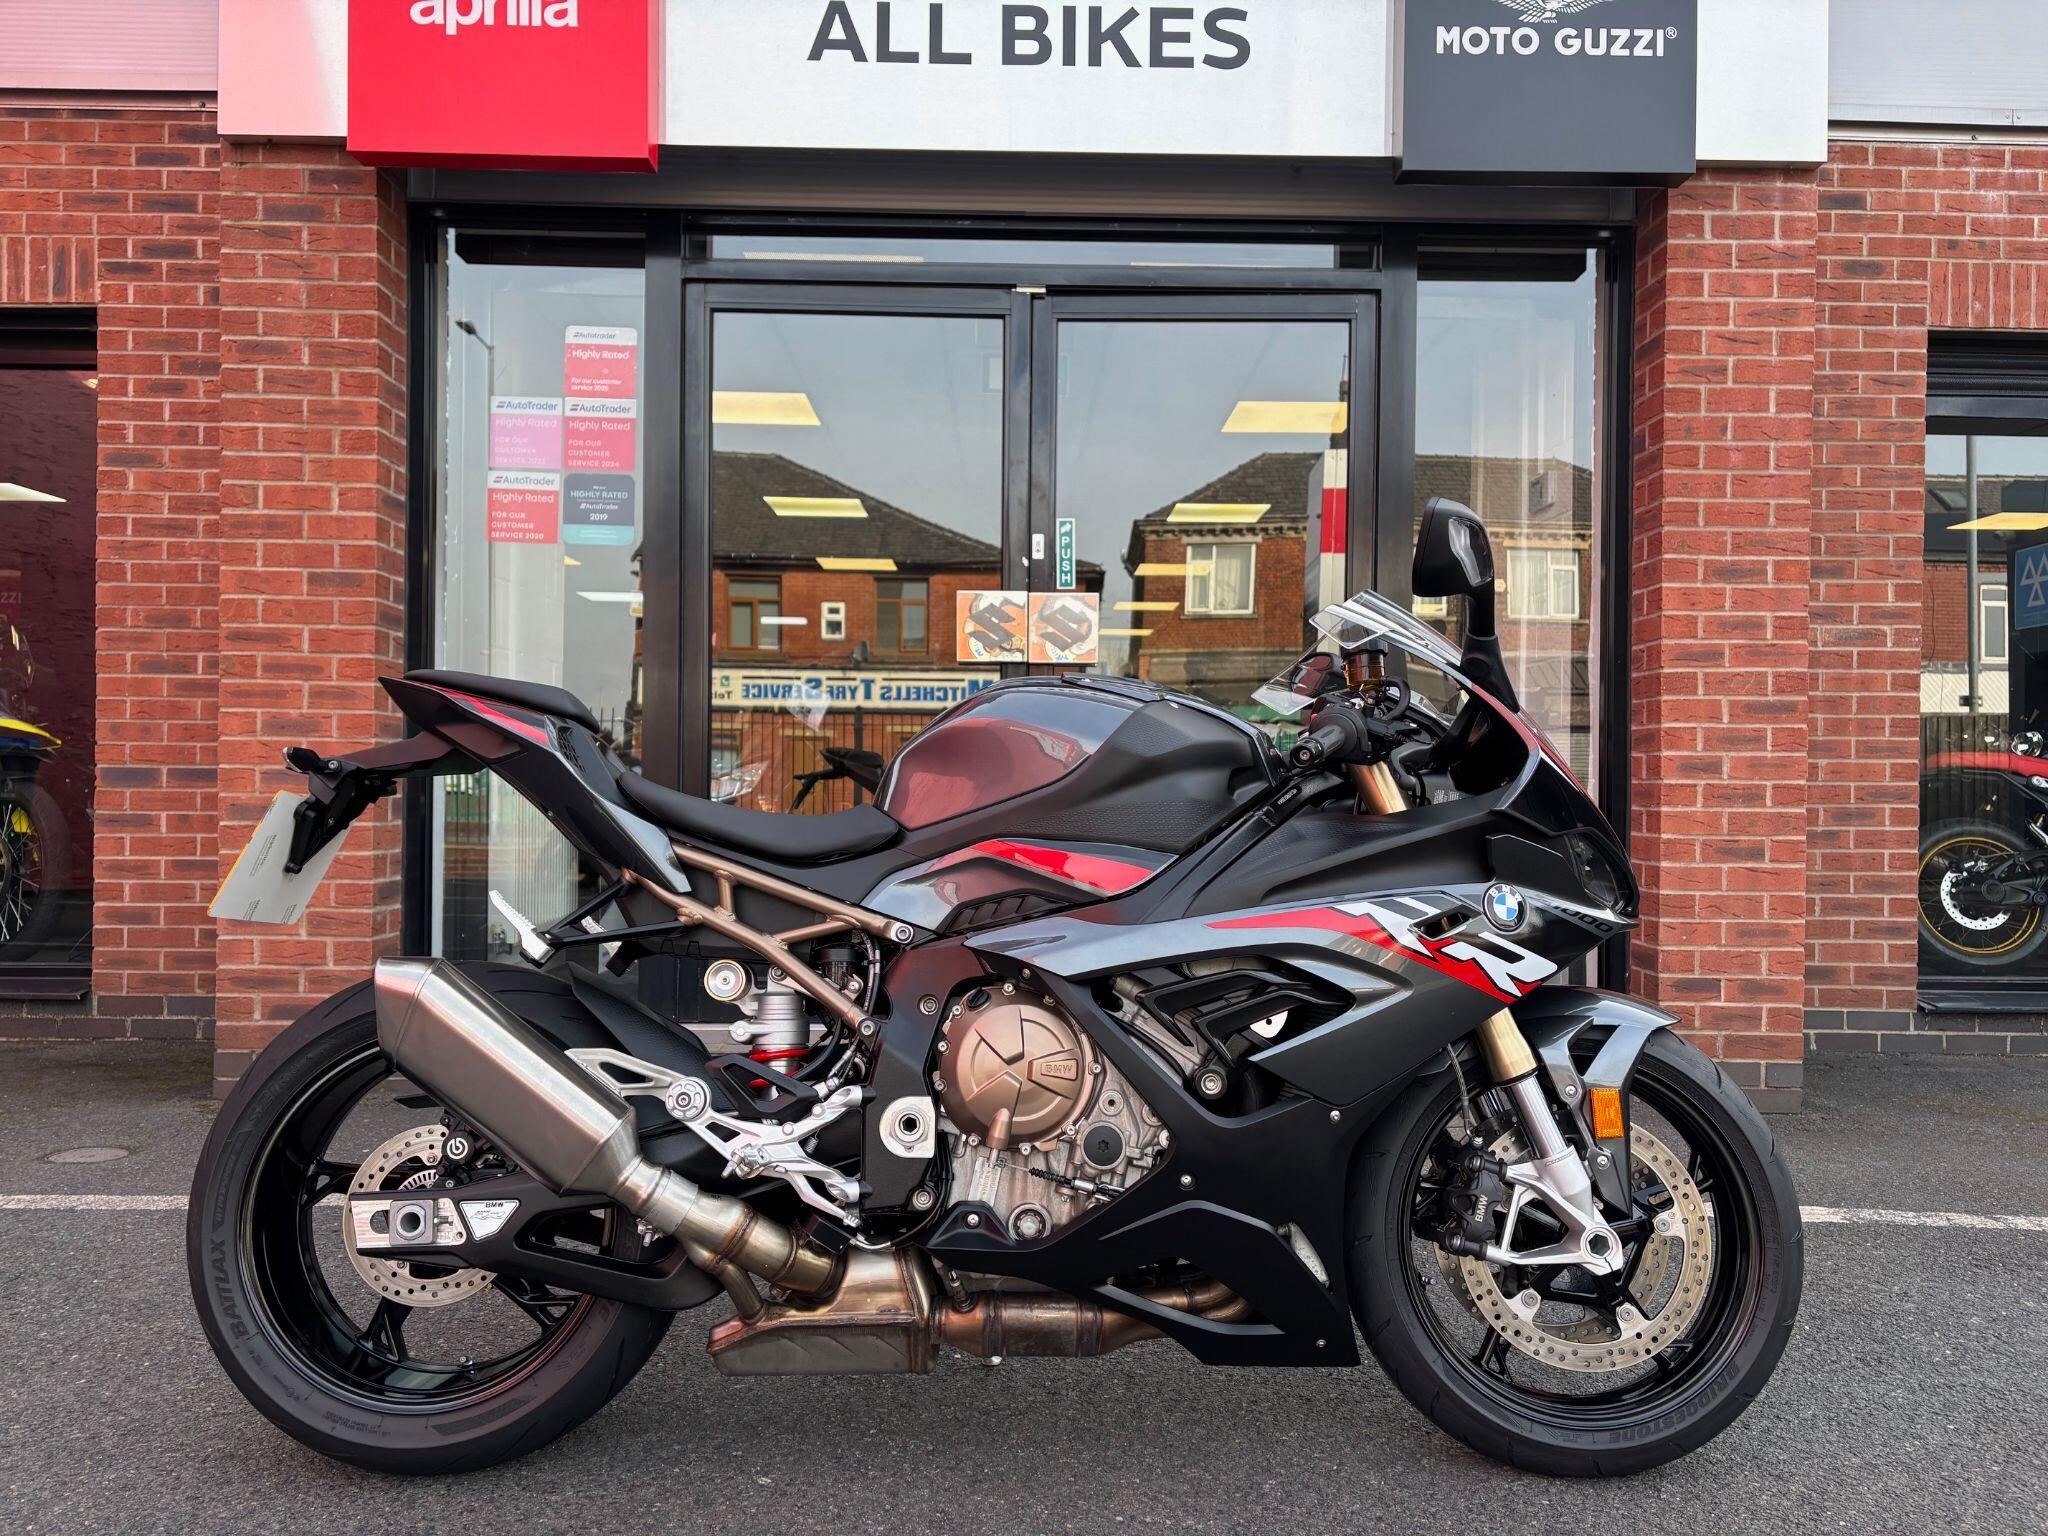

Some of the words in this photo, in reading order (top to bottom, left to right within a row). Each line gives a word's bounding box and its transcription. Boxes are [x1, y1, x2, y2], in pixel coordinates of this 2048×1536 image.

[807, 0, 972, 64] ALL
[1002, 4, 1250, 70] BIKES
[1436, 26, 1540, 55] MOTO
[572, 350, 600, 360] Highly
[602, 350, 629, 360] Rated
[506, 401, 558, 411] AutoTrader
[580, 403, 631, 414] AutoTrader
[495, 417, 525, 429] Highly
[528, 417, 557, 428] Rated
[569, 420, 600, 431] Highly
[601, 421, 630, 431] Rated
[568, 439, 583, 447] FOR
[568, 449, 610, 457] CUSTOMER
[568, 459, 599, 467] SERVICE
[503, 475, 555, 486] AutoTrader
[493, 492, 523, 503] Highly
[525, 493, 554, 504] Rated
[570, 490, 600, 499] HIGHLY
[602, 491, 628, 499] RATED
[509, 511, 526, 519] OUR
[589, 513, 608, 521] 2019
[491, 521, 534, 529] CUSTOMER
[1061, 536, 1071, 584] PUSH
[1045, 1063, 1073, 1074] BMW
[1475, 1194, 1488, 1223] BMW
[211, 1238, 250, 1340] BATTLAX
